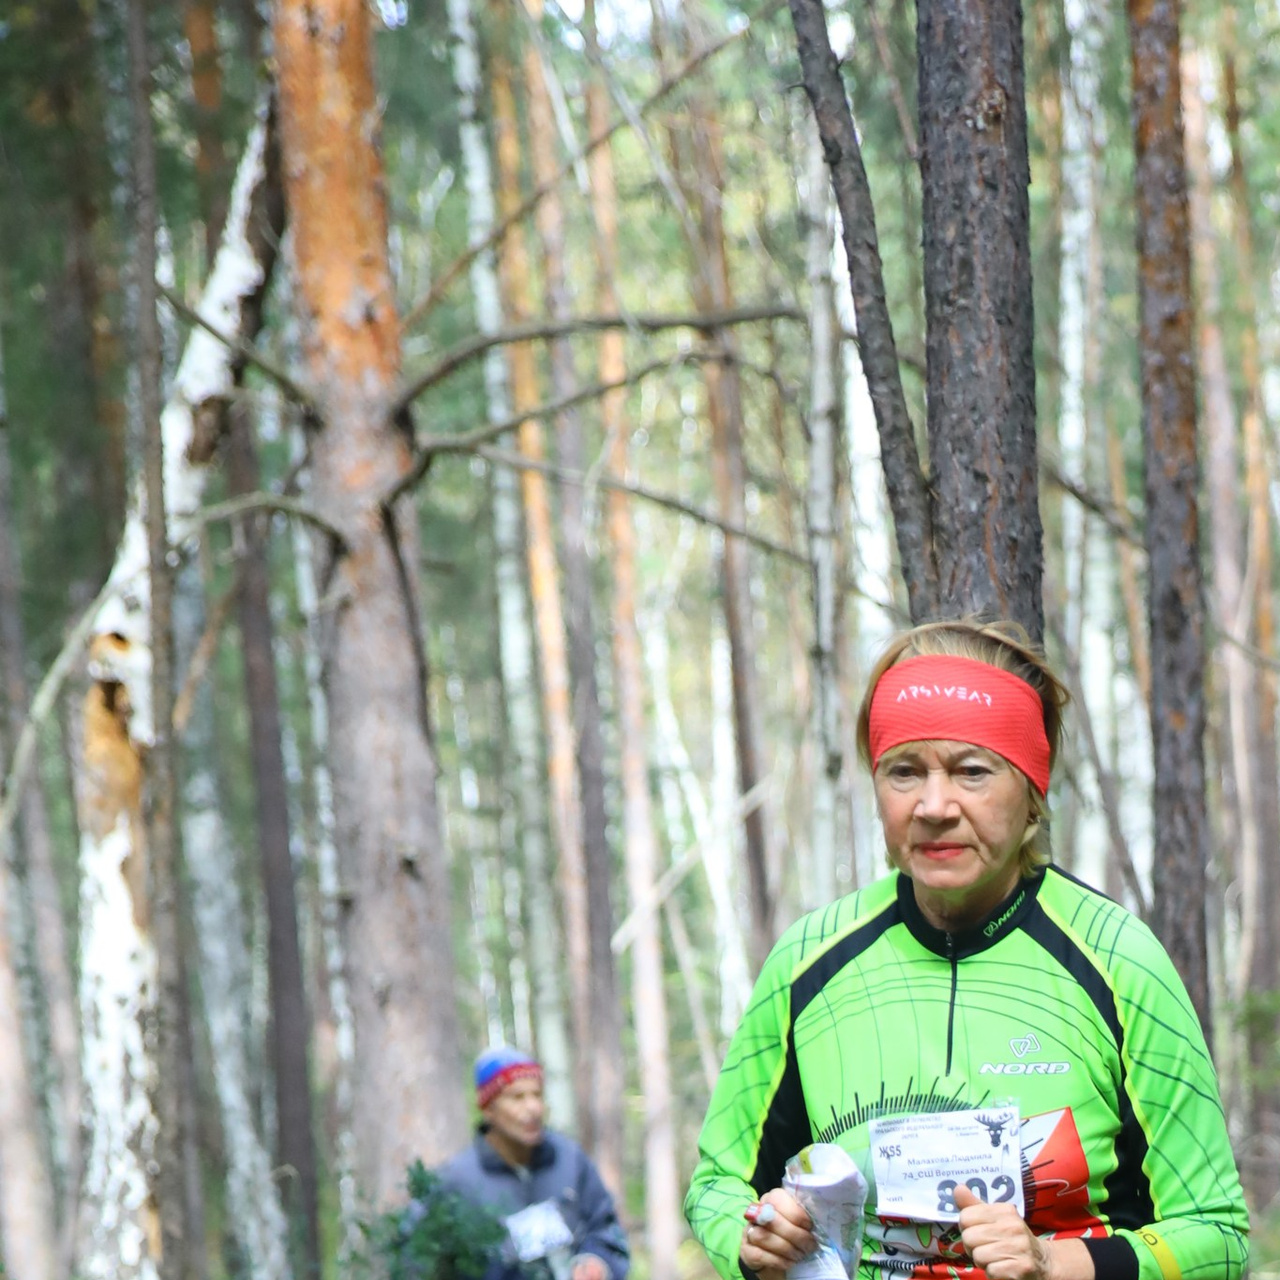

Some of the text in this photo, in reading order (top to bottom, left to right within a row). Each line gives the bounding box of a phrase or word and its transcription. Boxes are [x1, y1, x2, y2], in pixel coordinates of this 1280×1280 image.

[978, 1062, 1071, 1075] NORD
[907, 1153, 993, 1166] Малахова Людмила
[935, 1168, 980, 1178] Вертикаль
[981, 1165, 1000, 1174] Мал
